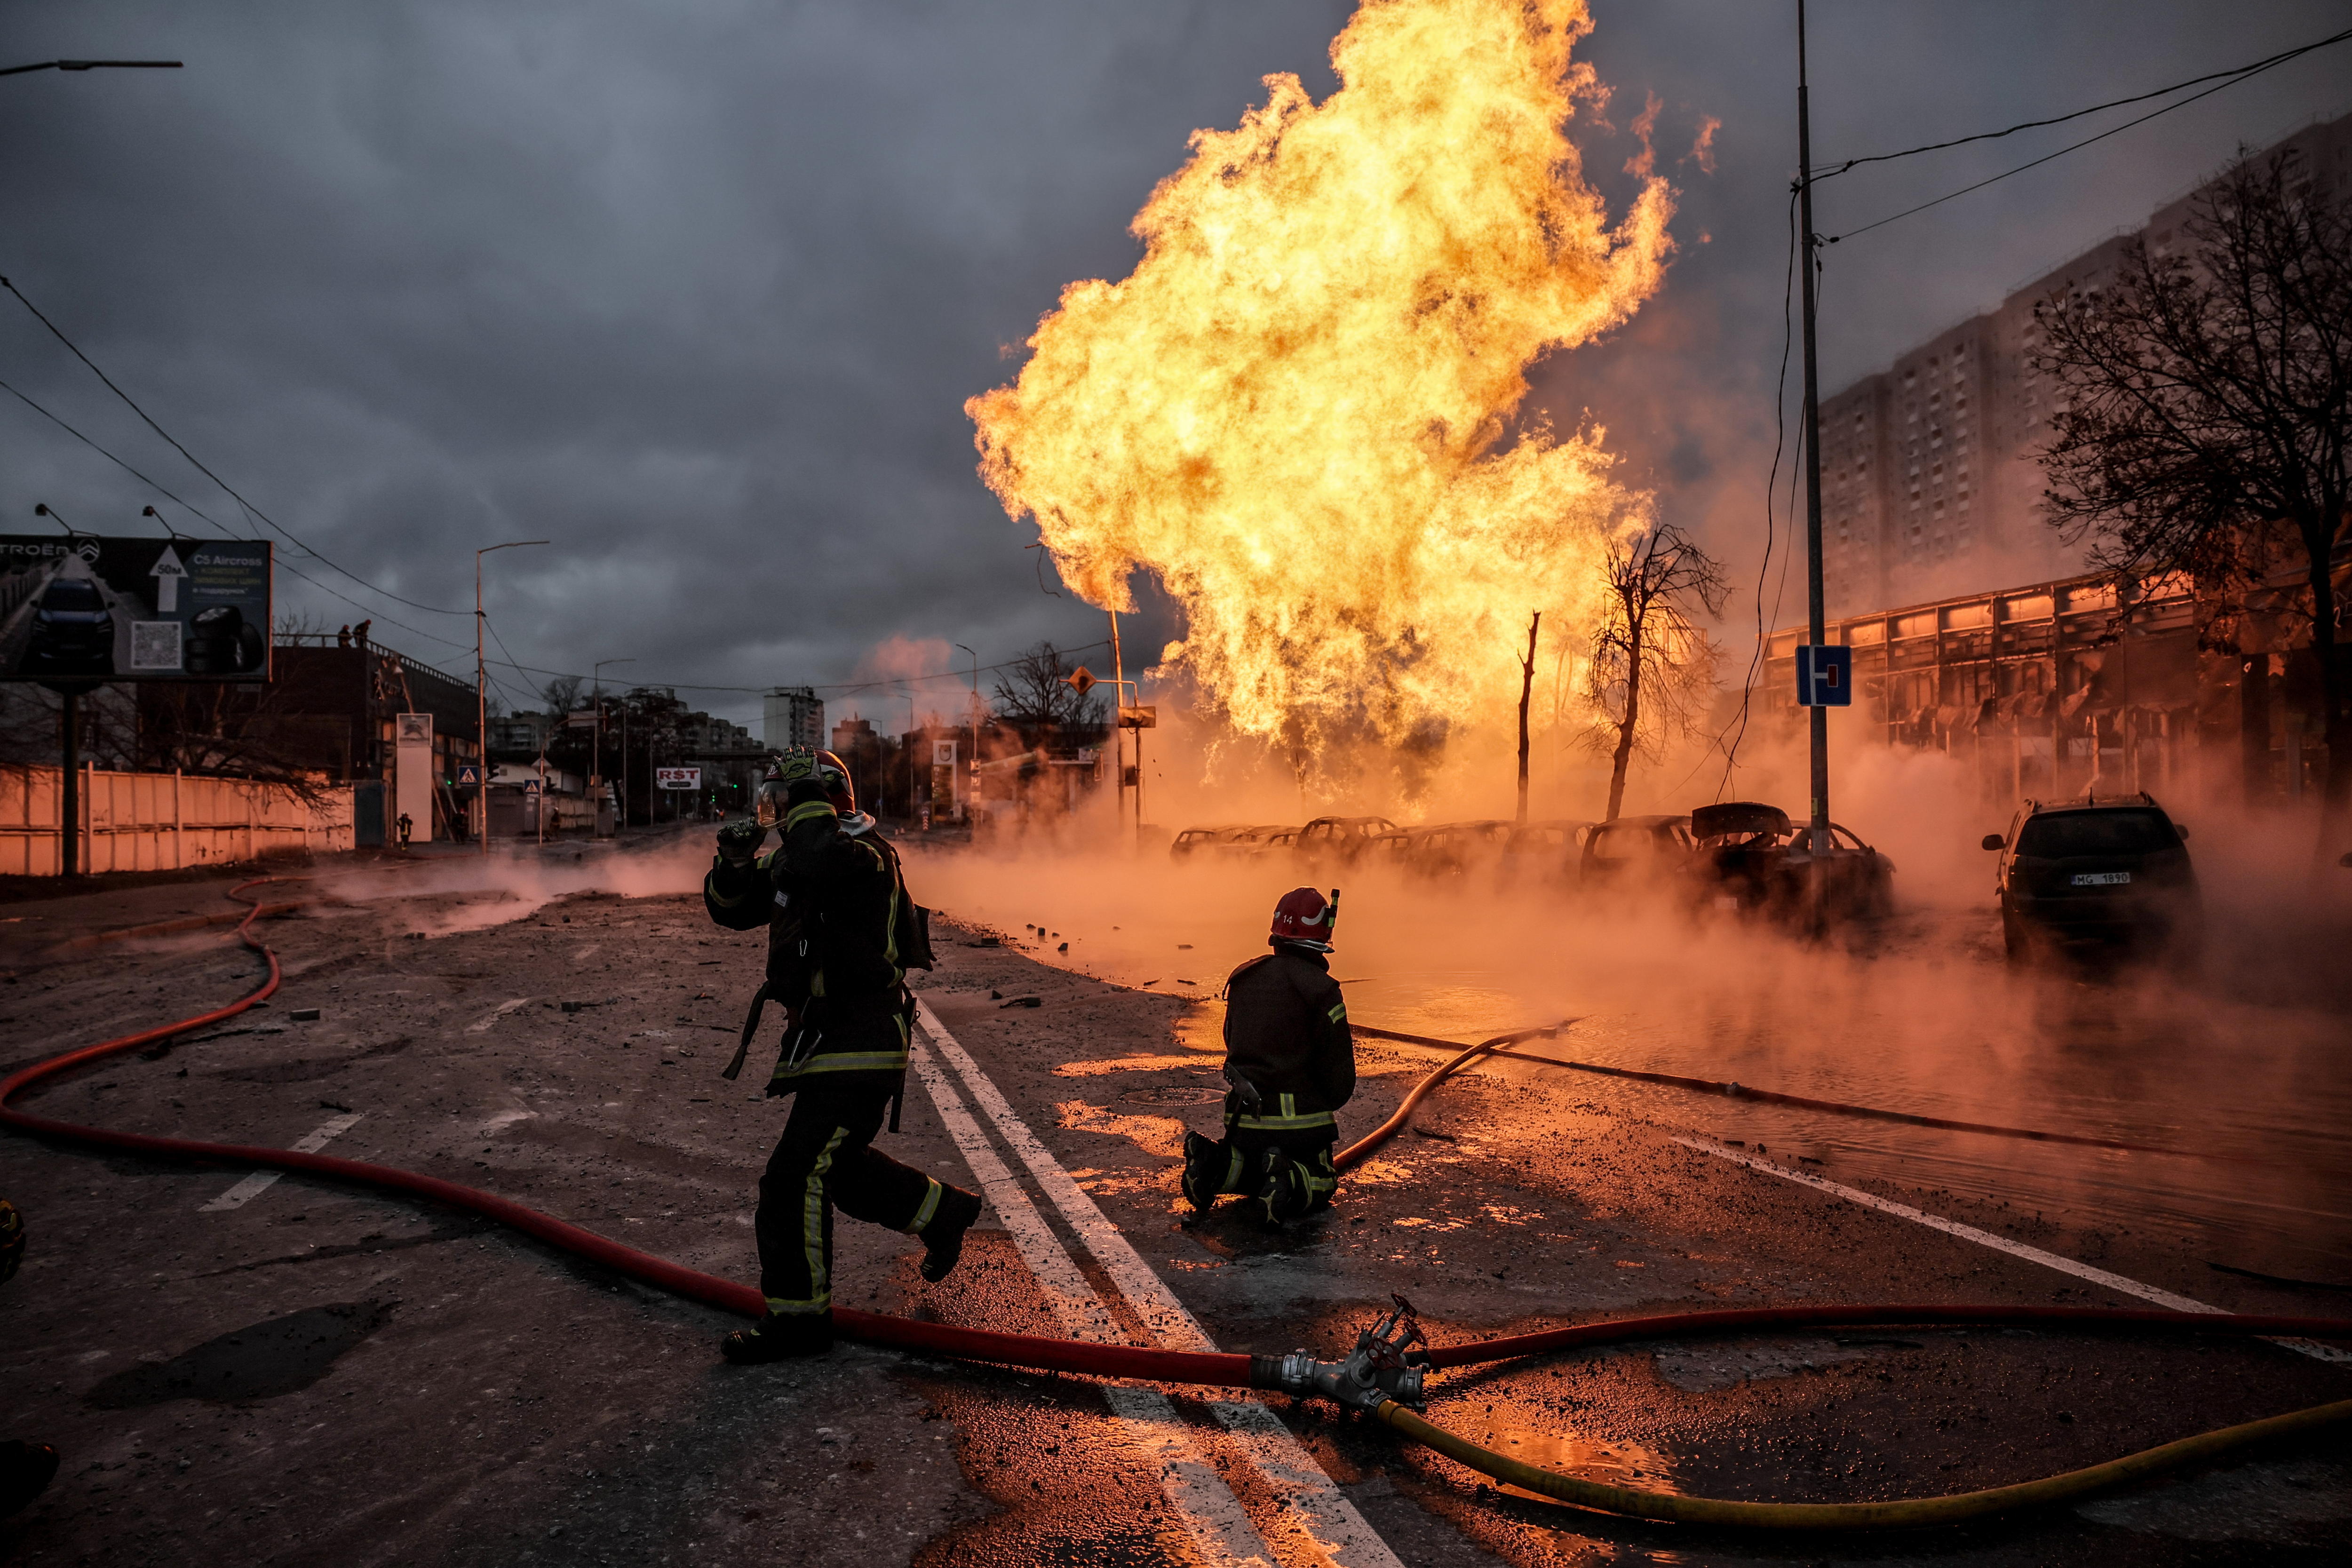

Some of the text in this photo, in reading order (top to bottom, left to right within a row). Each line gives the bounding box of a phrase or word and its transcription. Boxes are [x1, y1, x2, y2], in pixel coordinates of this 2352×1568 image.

[213, 556, 262, 566] Aircross
[659, 770, 699, 780] RST
[2077, 873, 2128, 884] MG 1890
[1283, 914, 1293, 925] 14
